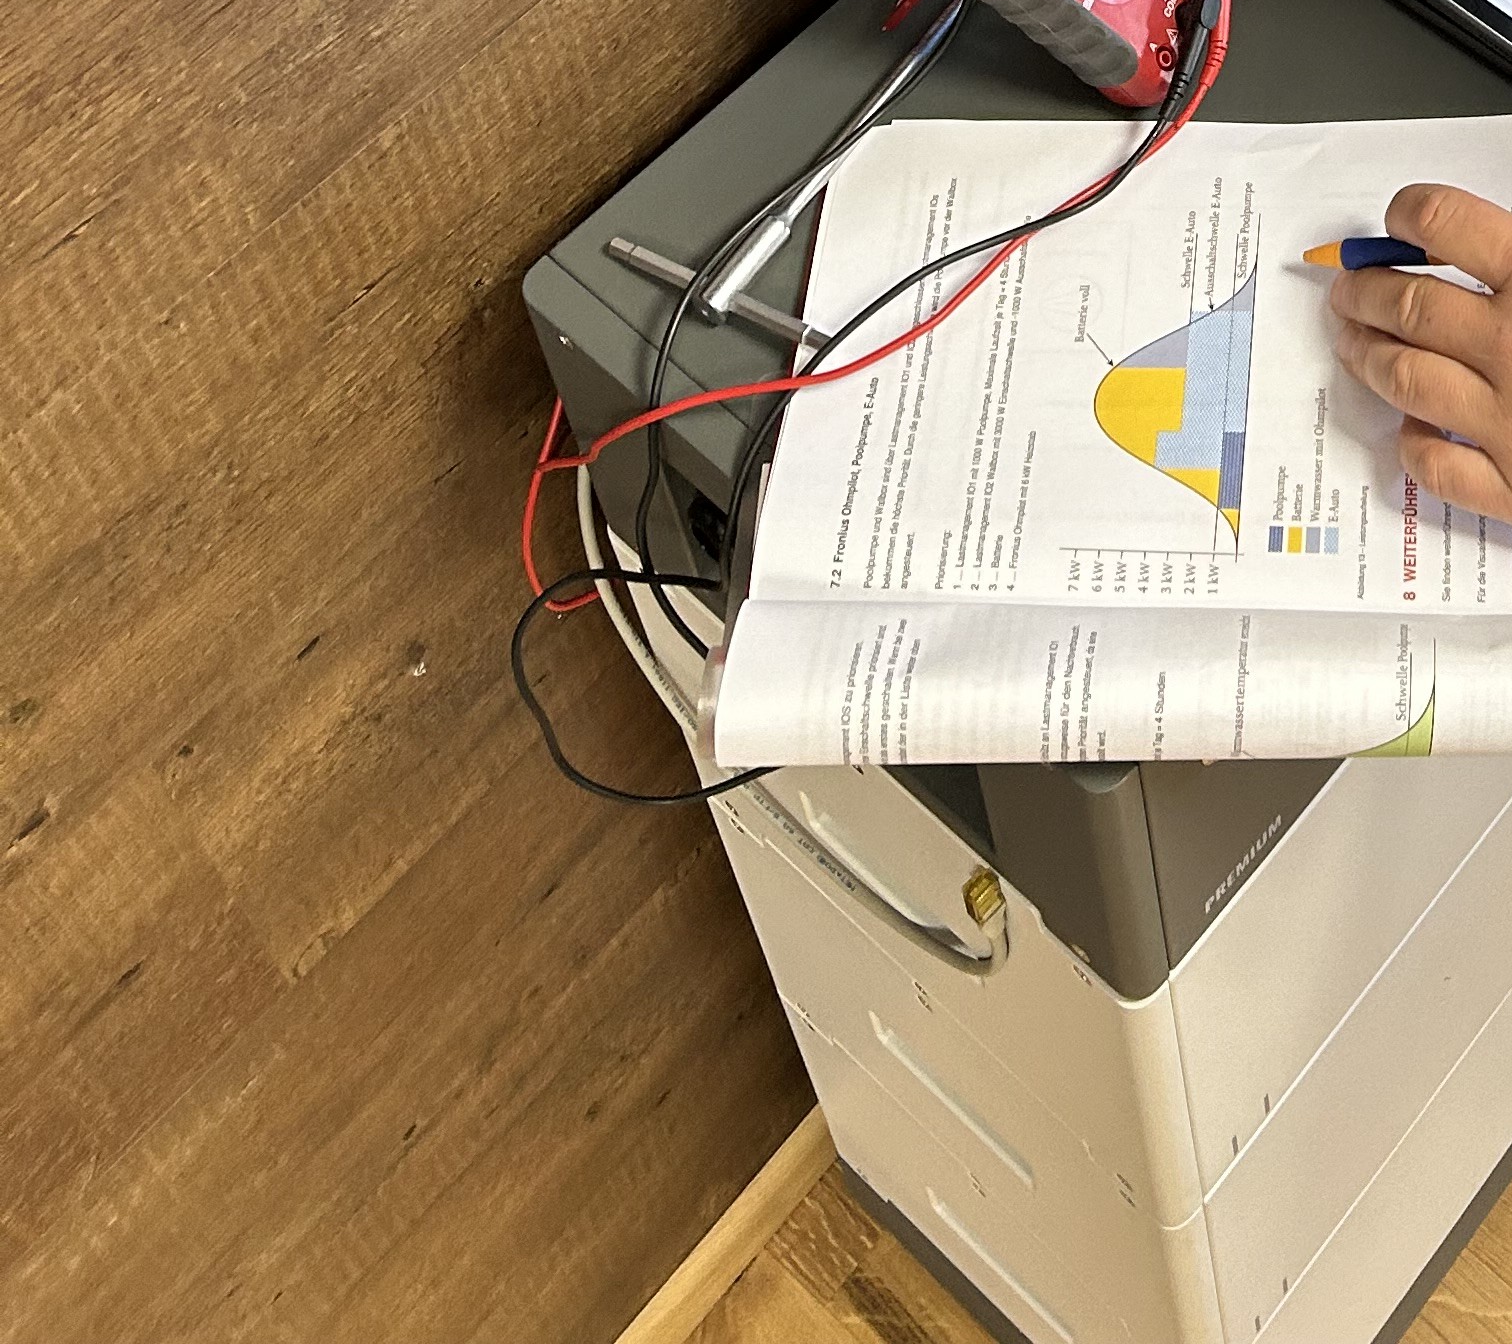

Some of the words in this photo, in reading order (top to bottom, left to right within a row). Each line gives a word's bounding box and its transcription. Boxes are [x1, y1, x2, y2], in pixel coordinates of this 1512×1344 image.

[1210, 176, 1223, 209] E-Auto
[1239, 181, 1255, 235] Poolpumpe
[1184, 210, 1198, 243] E-Auto
[1180, 245, 1195, 288] Schwelle
[1203, 211, 1221, 297] Ausschaltschwelle
[1236, 236, 1250, 278] Schwelle
[1079, 284, 1092, 302] voll
[1074, 304, 1089, 342] Batterie
[863, 377, 879, 409] E-Auto
[1313, 387, 1329, 437] Ohmpilot
[851, 412, 874, 467] Poolpumpe,
[840, 469, 861, 517] Ohmpilot,
[1272, 465, 1289, 522] Poolpumpe
[1291, 483, 1304, 523] Batterie
[1328, 488, 1341, 523] E-Auto
[833, 518, 850, 564] Fronius
[863, 534, 880, 589] Poolpumpe
[1069, 560, 1081, 582] kW
[1093, 561, 1104, 582] kW
[1115, 561, 1127, 583] kW
[1138, 561, 1150, 583] kW
[1161, 562, 1173, 584] kW
[1184, 563, 1197, 585] kW
[1208, 564, 1220, 586] kW
[829, 569, 842, 589] 7.2
[1067, 584, 1079, 593] 7
[1092, 584, 1103, 593] 6
[1115, 585, 1126, 593] 5
[1138, 586, 1149, 594] 4
[1161, 586, 1172, 594] 3
[1184, 586, 1196, 595] 2
[1476, 586, 1487, 604] Für
[1402, 591, 1416, 602] 8
[1154, 671, 1167, 714] Stunden
[1395, 664, 1408, 721] Schwelle
[1204, 814, 1282, 915] PREMIUM
